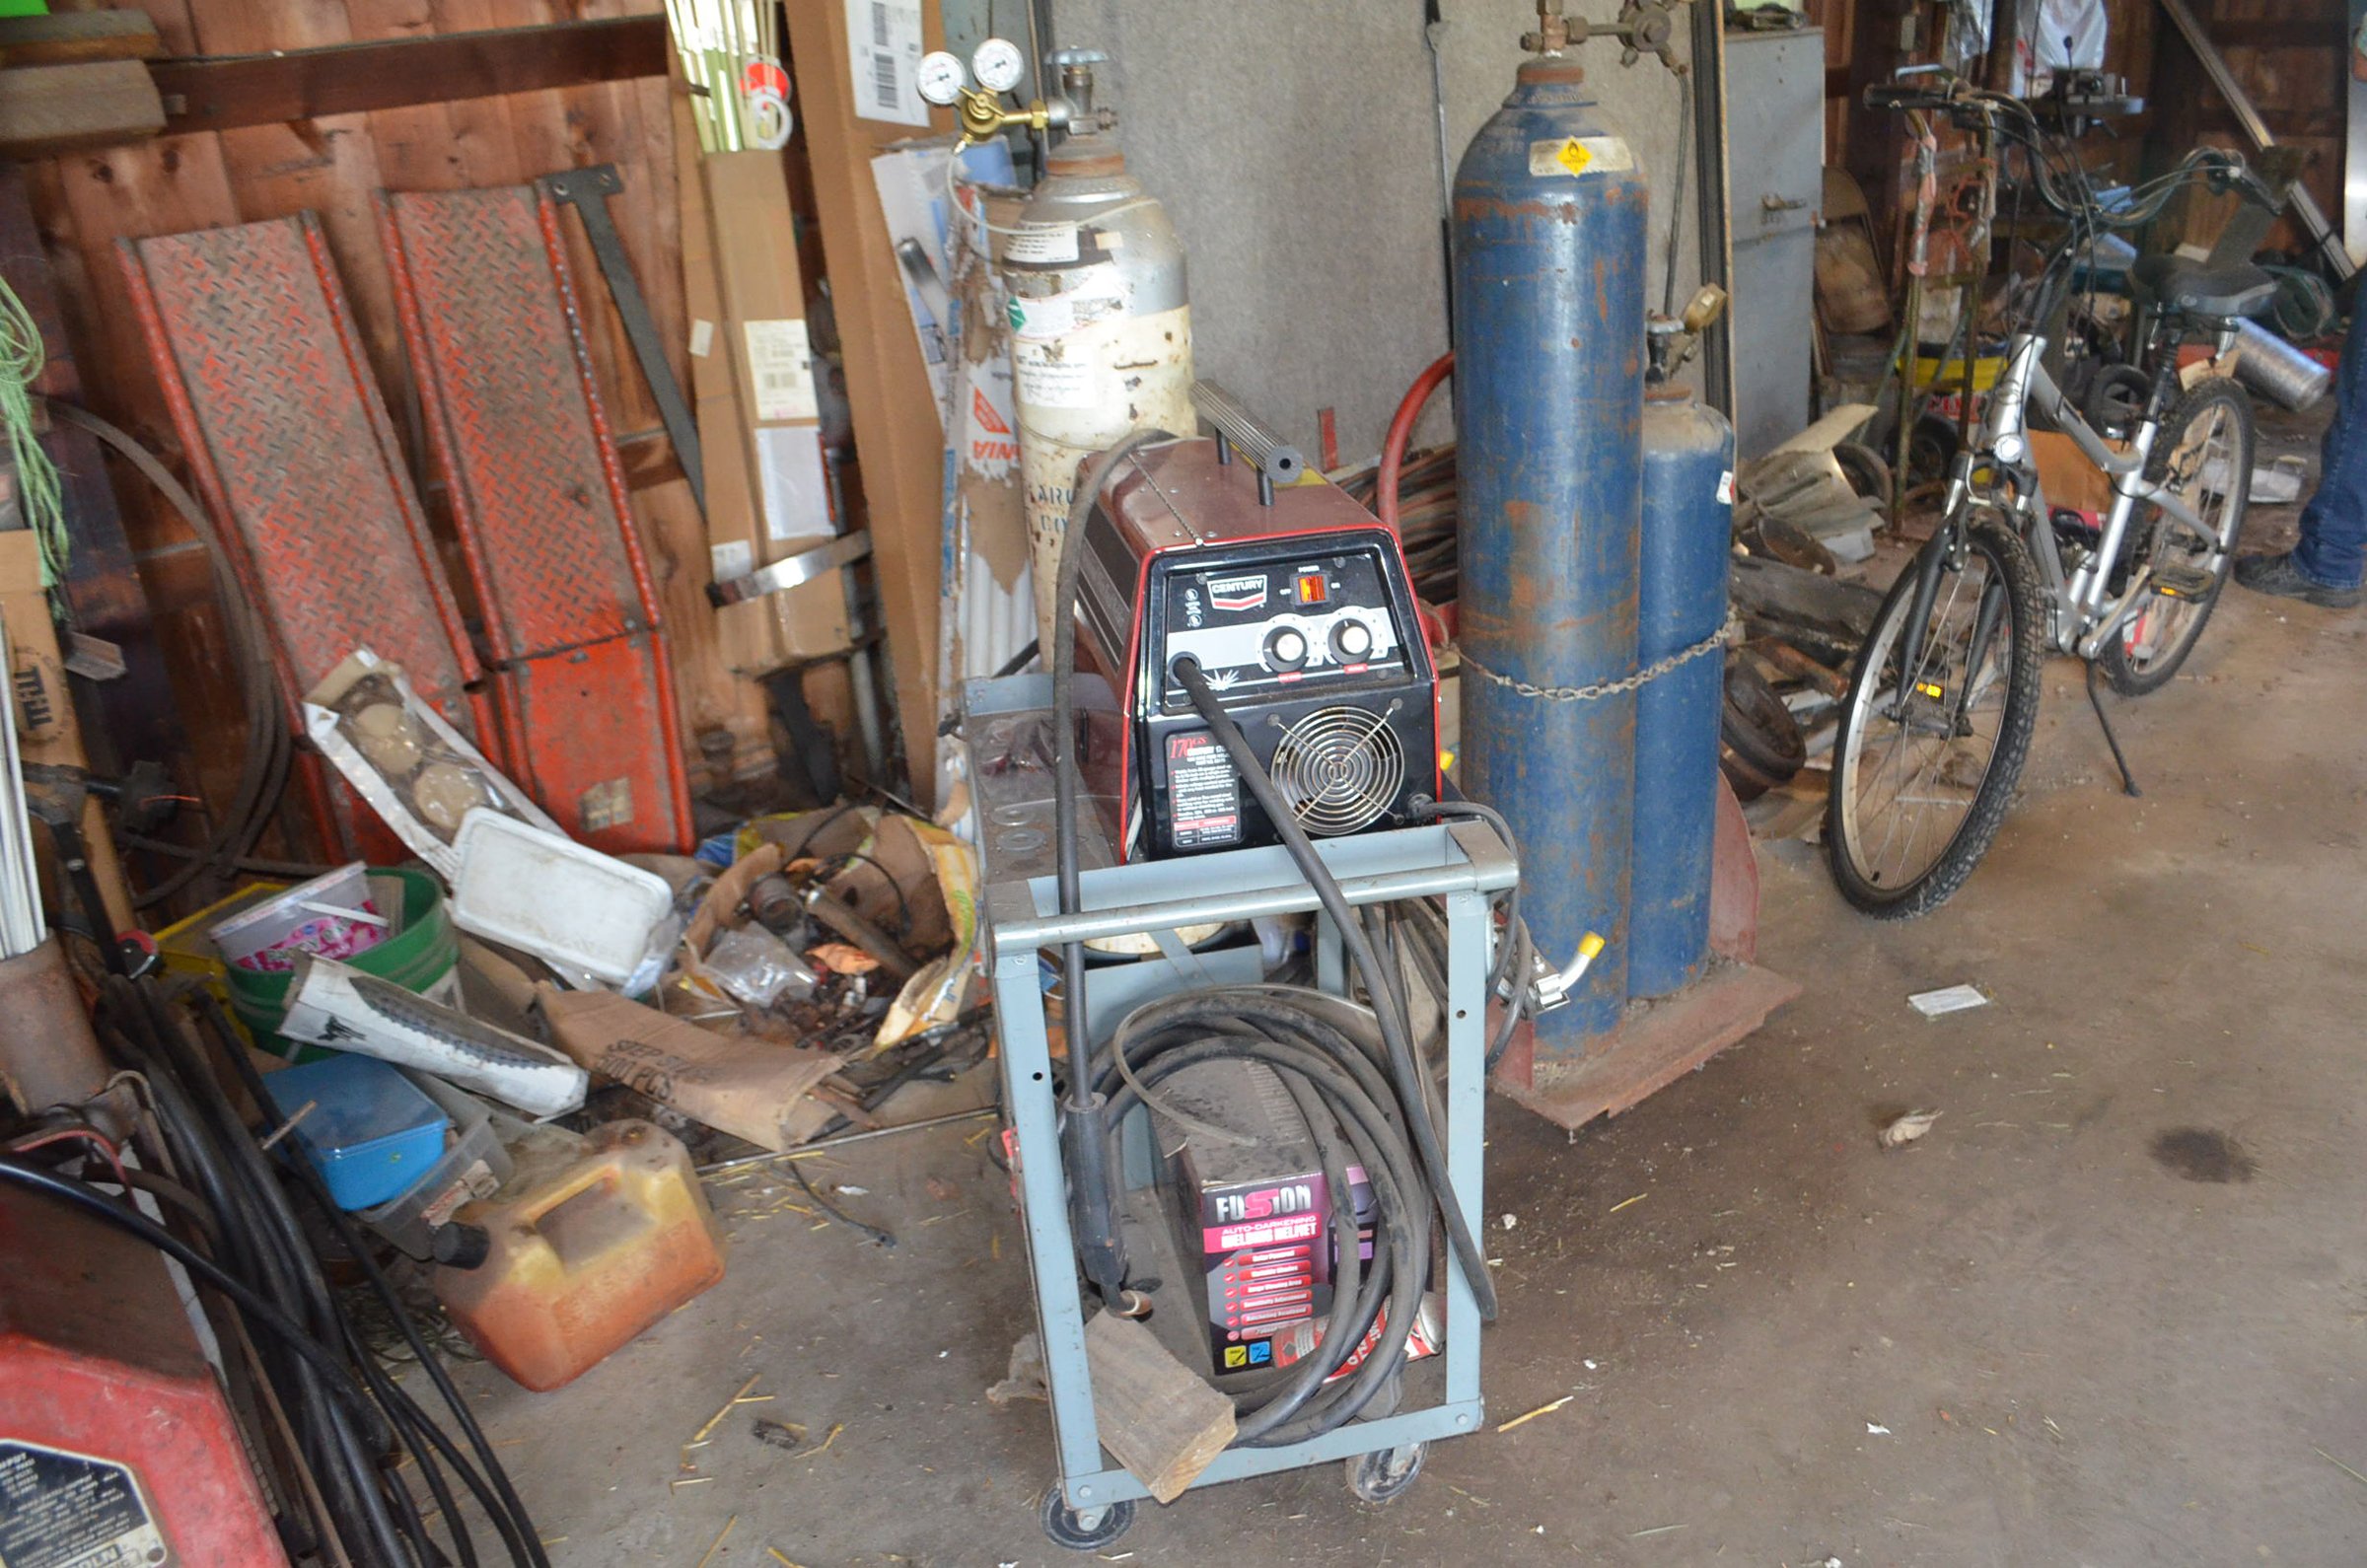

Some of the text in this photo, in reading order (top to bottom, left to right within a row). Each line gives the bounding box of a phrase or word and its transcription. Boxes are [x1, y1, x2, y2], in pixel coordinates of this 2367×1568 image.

[1212, 579, 1262, 594] CENTURY
[1215, 1184, 1312, 1223] FUSION
[1222, 1215, 1317, 1235] AUTO-DARKENING
[1273, 1222, 1317, 1242] HELMET
